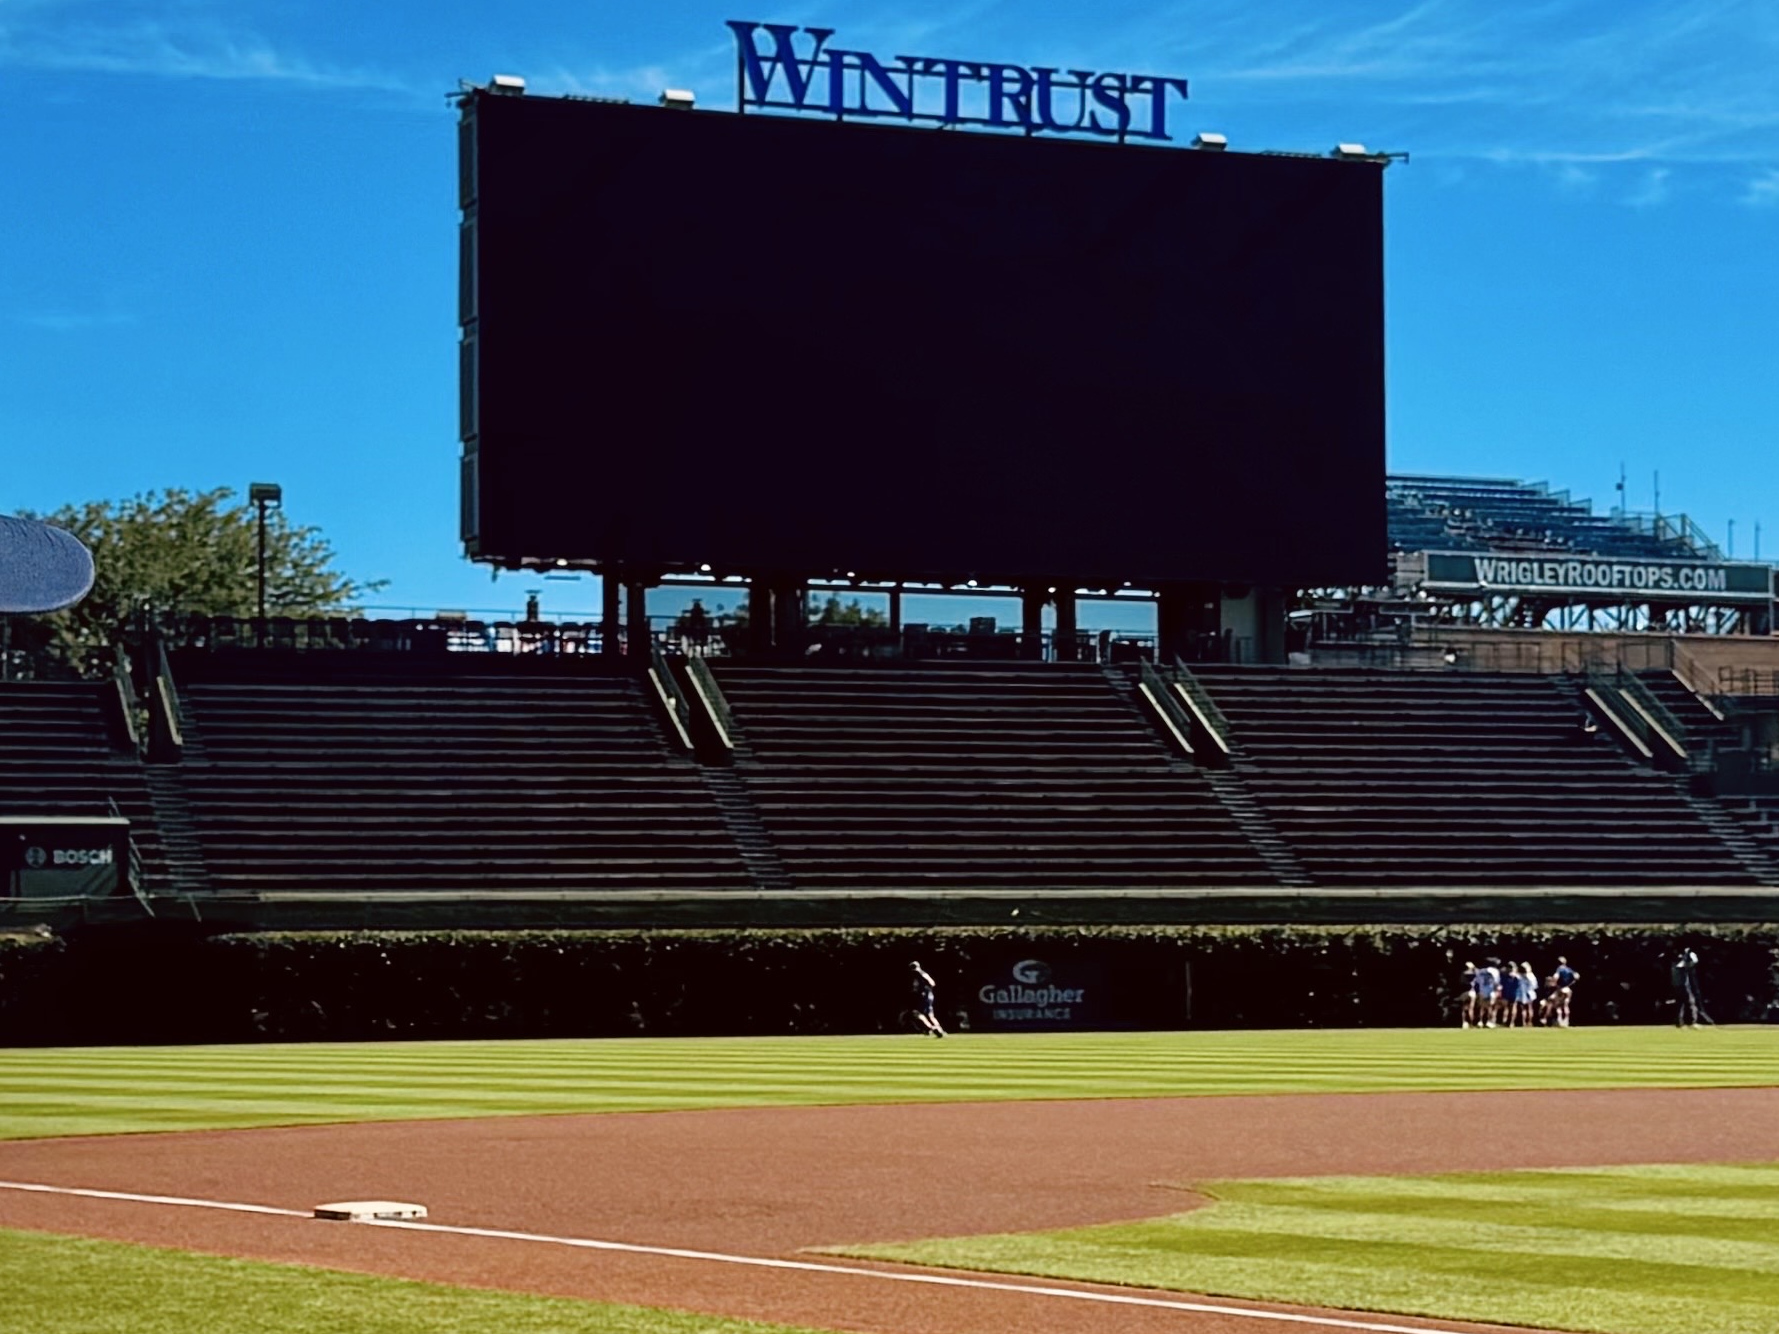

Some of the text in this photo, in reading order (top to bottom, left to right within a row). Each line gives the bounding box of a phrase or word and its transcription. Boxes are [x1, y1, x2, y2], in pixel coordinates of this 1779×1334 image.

[727, 21, 1188, 140] WINTRUST
[54, 849, 113, 865] BOSCH
[979, 984, 1084, 1006] Gallagher
[993, 1008, 1070, 1020] INSURANCE
